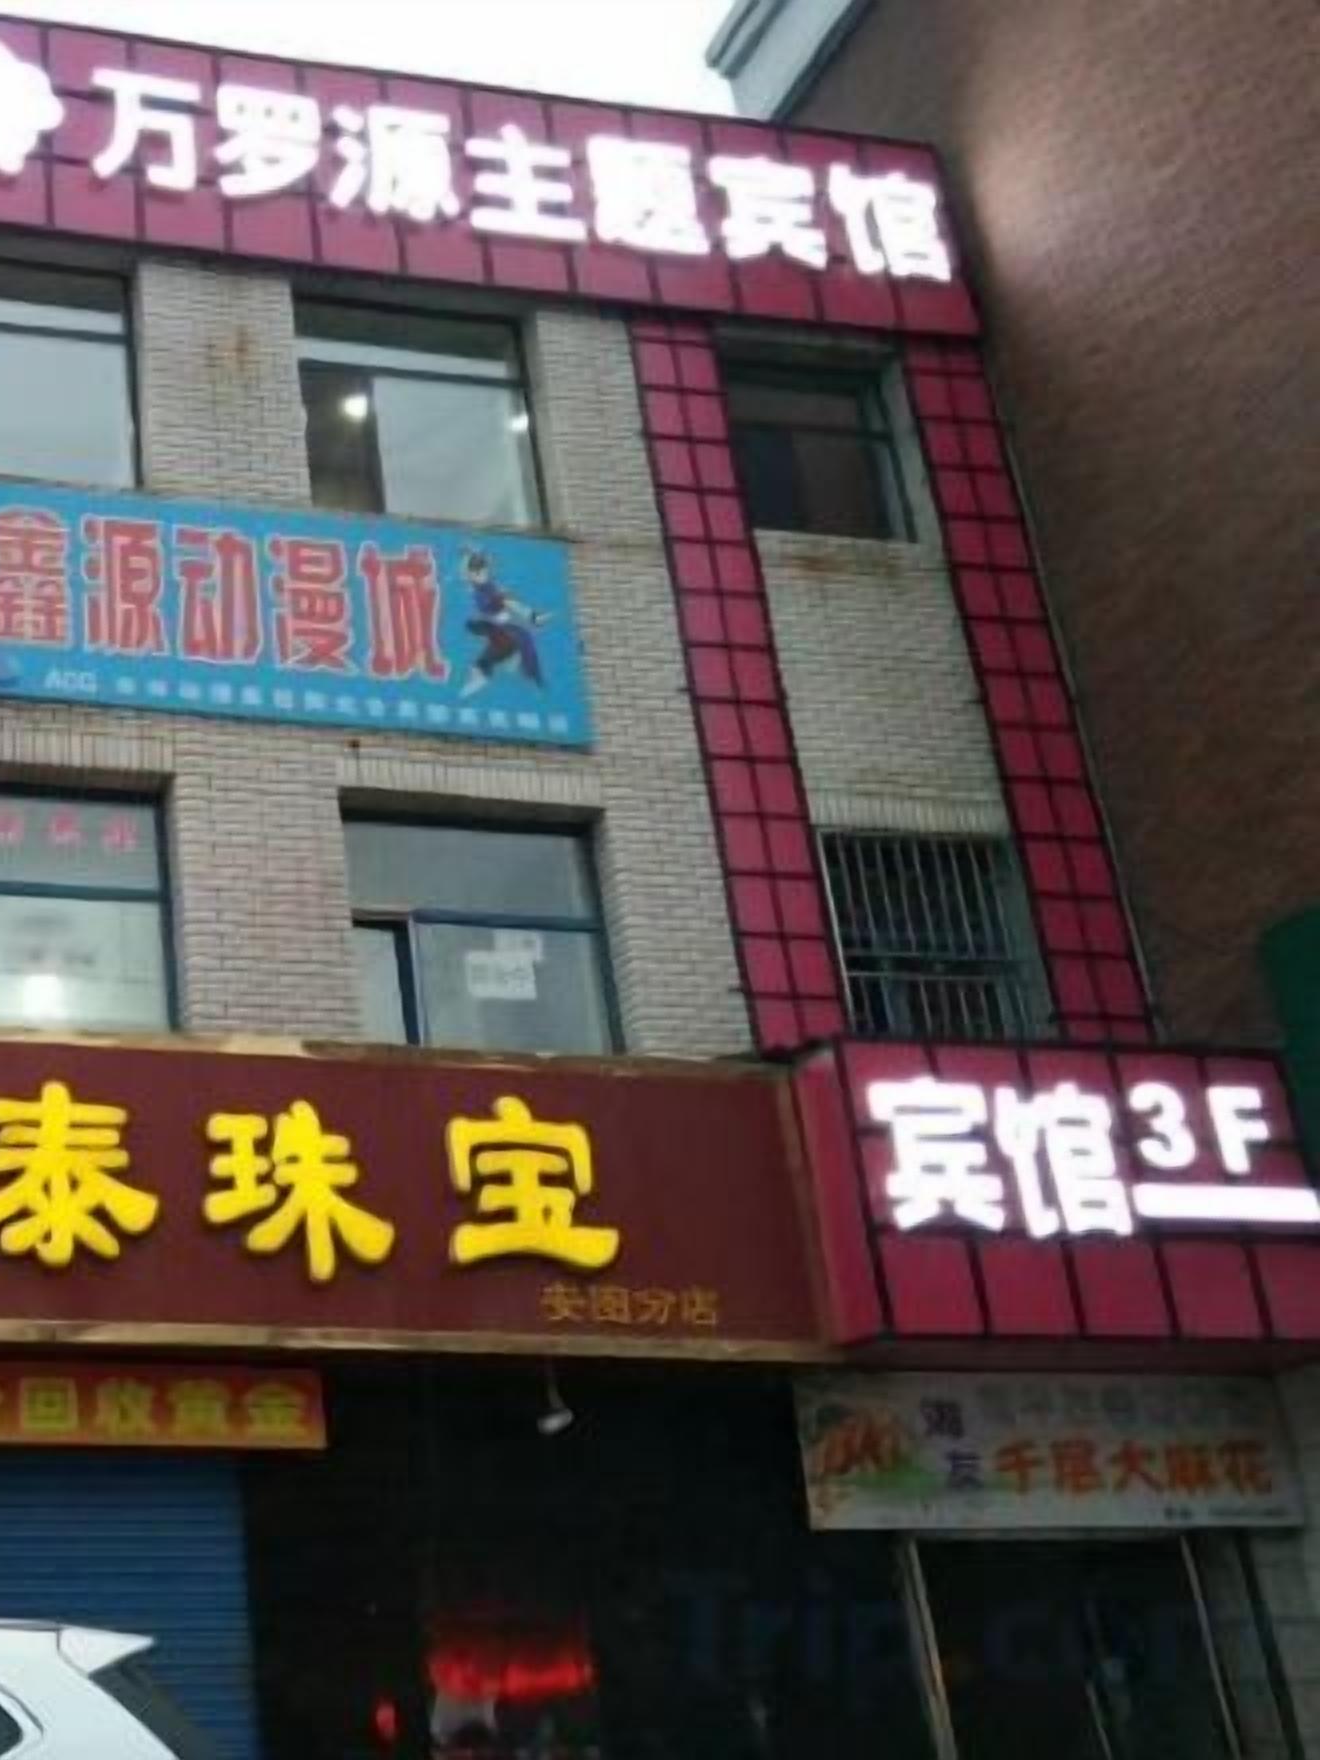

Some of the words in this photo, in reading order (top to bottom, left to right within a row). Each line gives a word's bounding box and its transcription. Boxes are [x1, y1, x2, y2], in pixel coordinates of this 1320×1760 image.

[89, 68, 953, 283] 万罗源主题宾馆
[866, 1077, 1133, 1238] 宾馆
[1127, 1081, 1271, 1174] 3F
